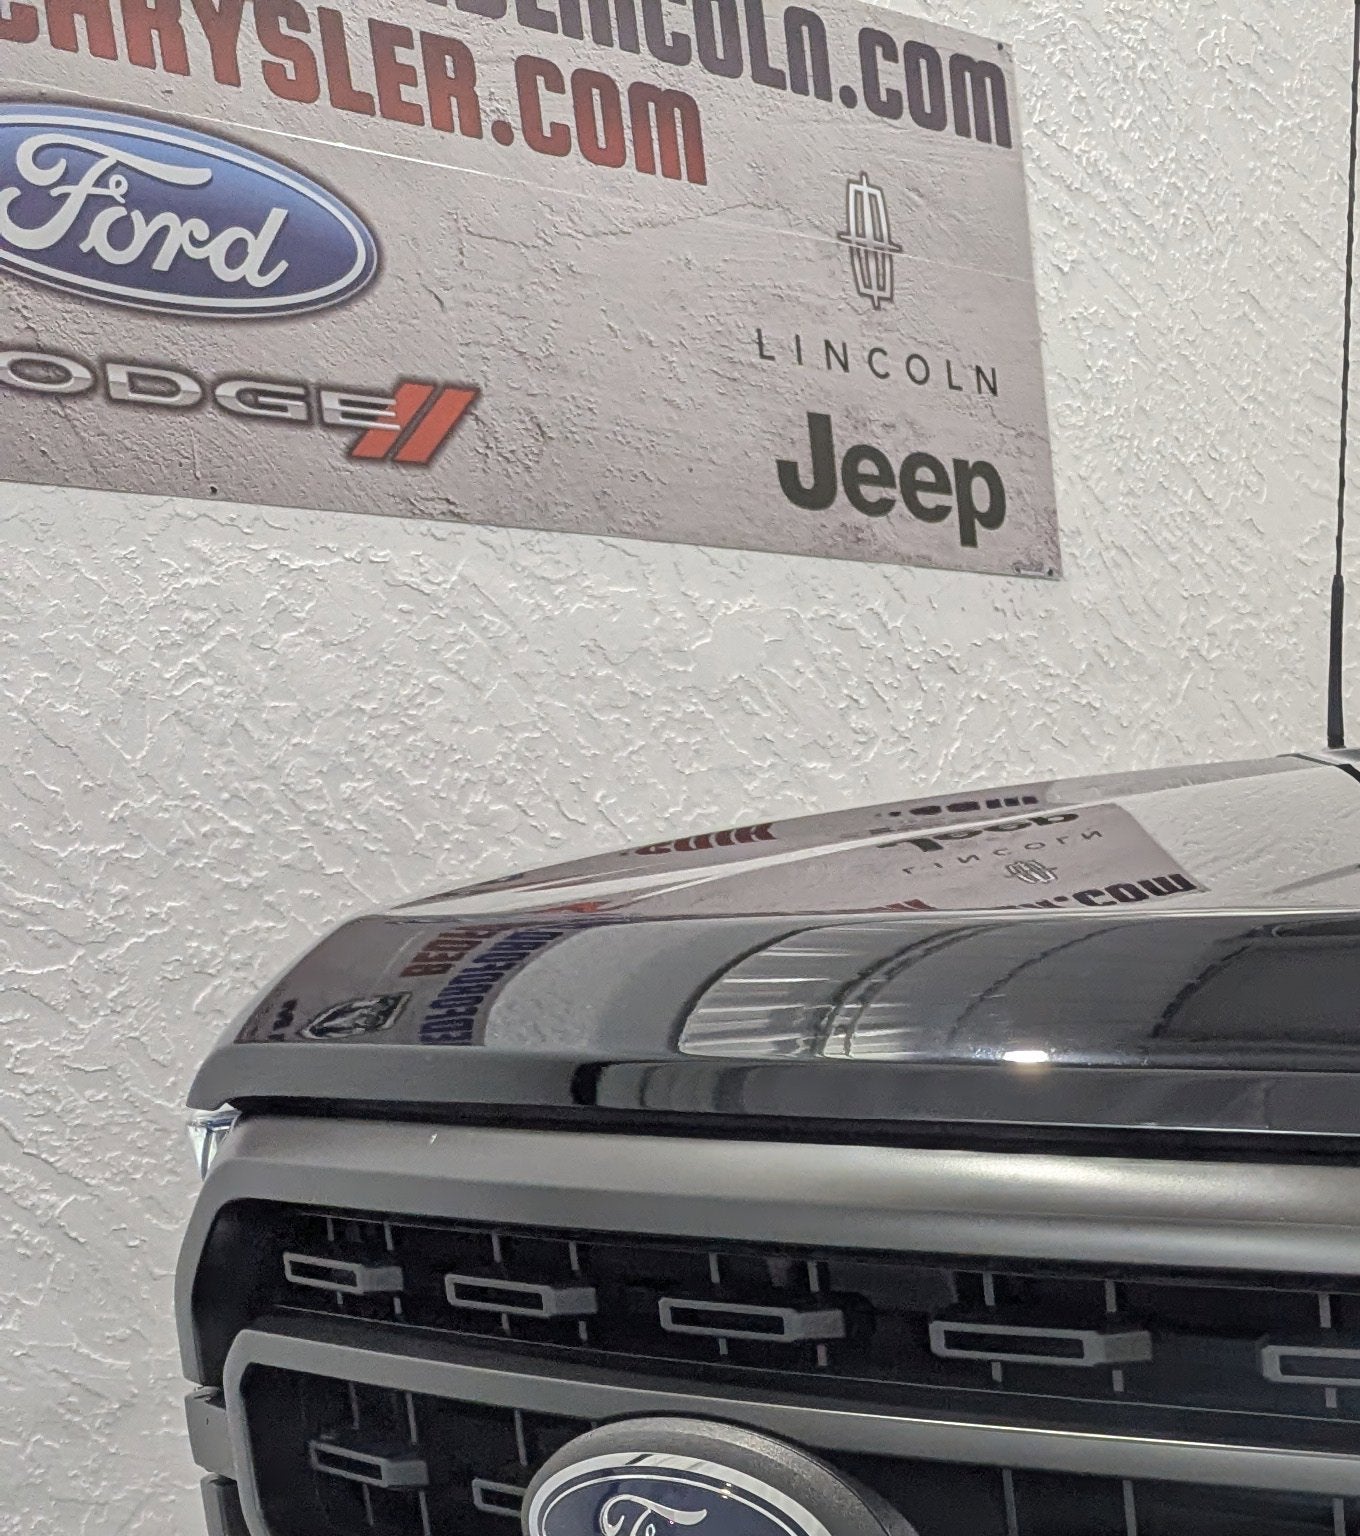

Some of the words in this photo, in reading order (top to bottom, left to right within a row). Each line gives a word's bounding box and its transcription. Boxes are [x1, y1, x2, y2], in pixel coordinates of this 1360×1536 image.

[0, 133, 289, 288] Ford
[756, 328, 998, 396] LINCOLN
[776, 411, 1006, 547] Jeep
